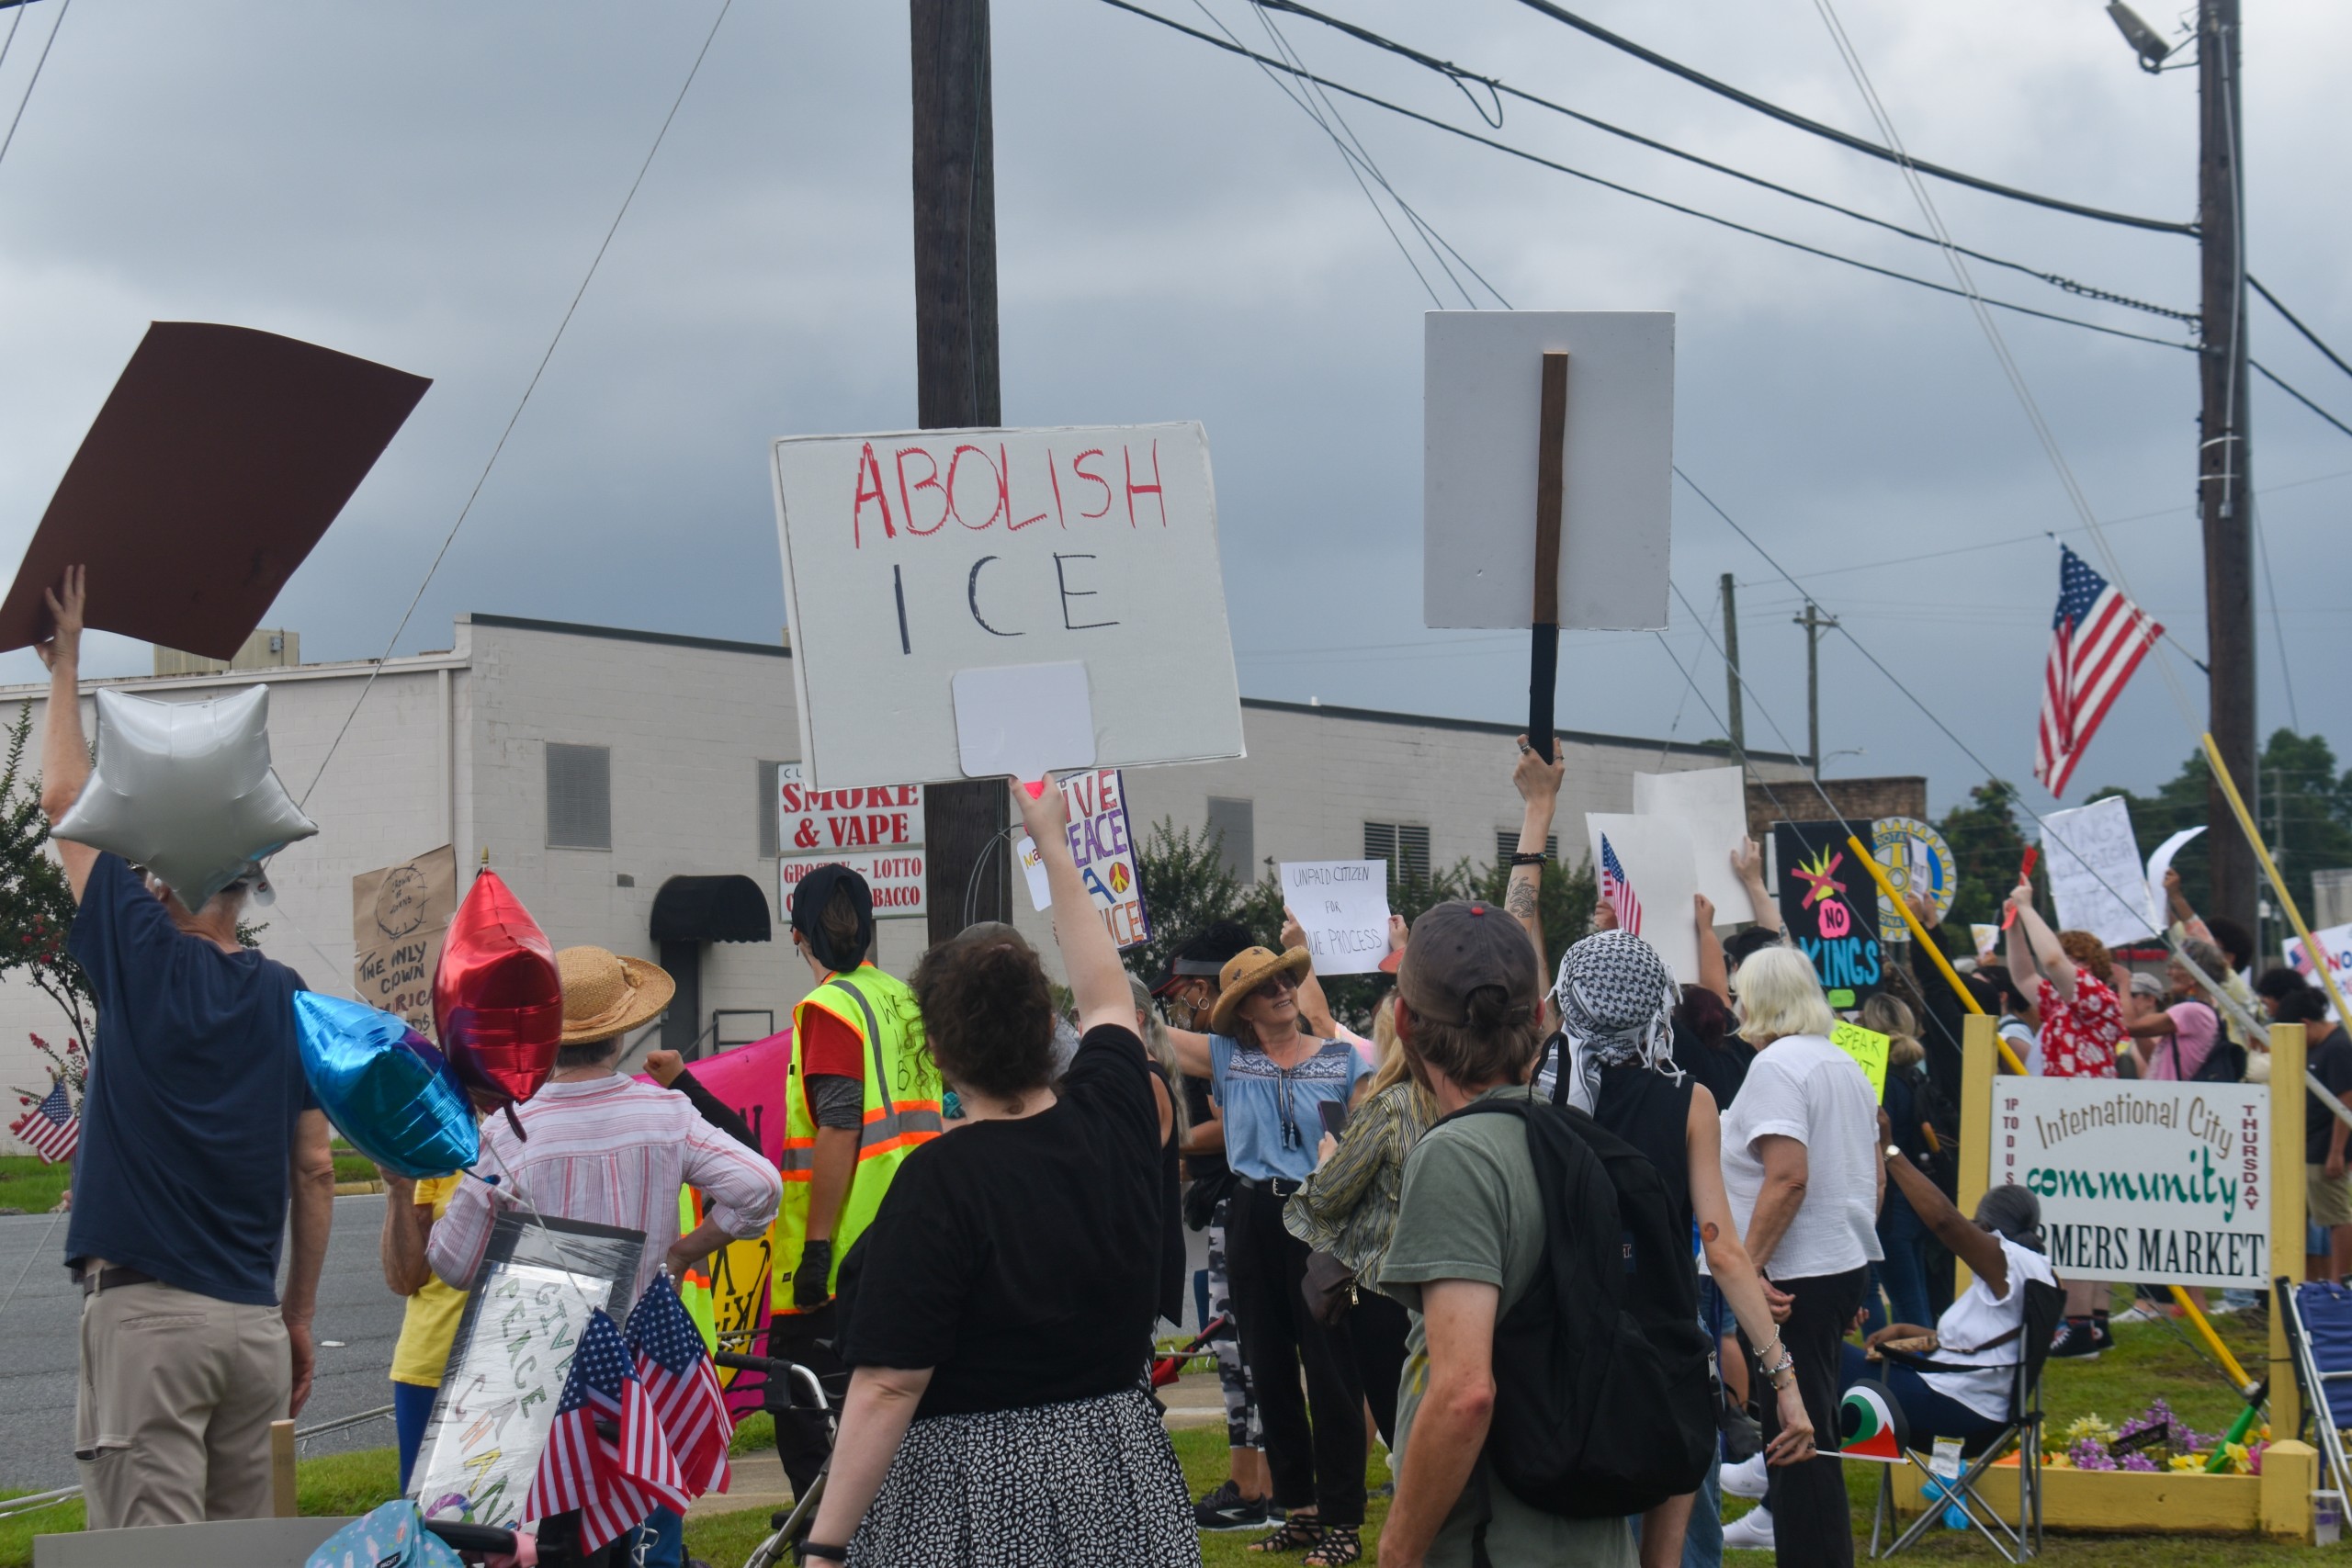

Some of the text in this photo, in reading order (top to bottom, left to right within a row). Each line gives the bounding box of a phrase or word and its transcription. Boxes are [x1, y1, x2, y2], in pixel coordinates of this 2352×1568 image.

[854, 438, 1167, 549] ABOLISH
[893, 551, 1121, 656] ICE
[782, 782, 920, 814] SMOKE
[794, 813, 910, 848] & VAPE
[1066, 808, 1128, 869] EACE
[874, 856, 922, 879] LOTTO
[1293, 866, 1370, 887] UNPAID CITIZEN
[872, 886, 921, 908] BACCO
[1325, 900, 1342, 914] FOR
[1825, 907, 1845, 930] NO
[1329, 929, 1383, 955] PROCESS
[359, 952, 386, 983] THE
[1799, 936, 1881, 988] KINGS
[1836, 1026, 1882, 1058] SPEAK
[2035, 1092, 2233, 1159] International City
[2242, 1105, 2260, 1211] THURSDAY
[2027, 1145, 2237, 1224] community
[2137, 1227, 2266, 1278] MARKET
[495, 1277, 548, 1418] PEACE
